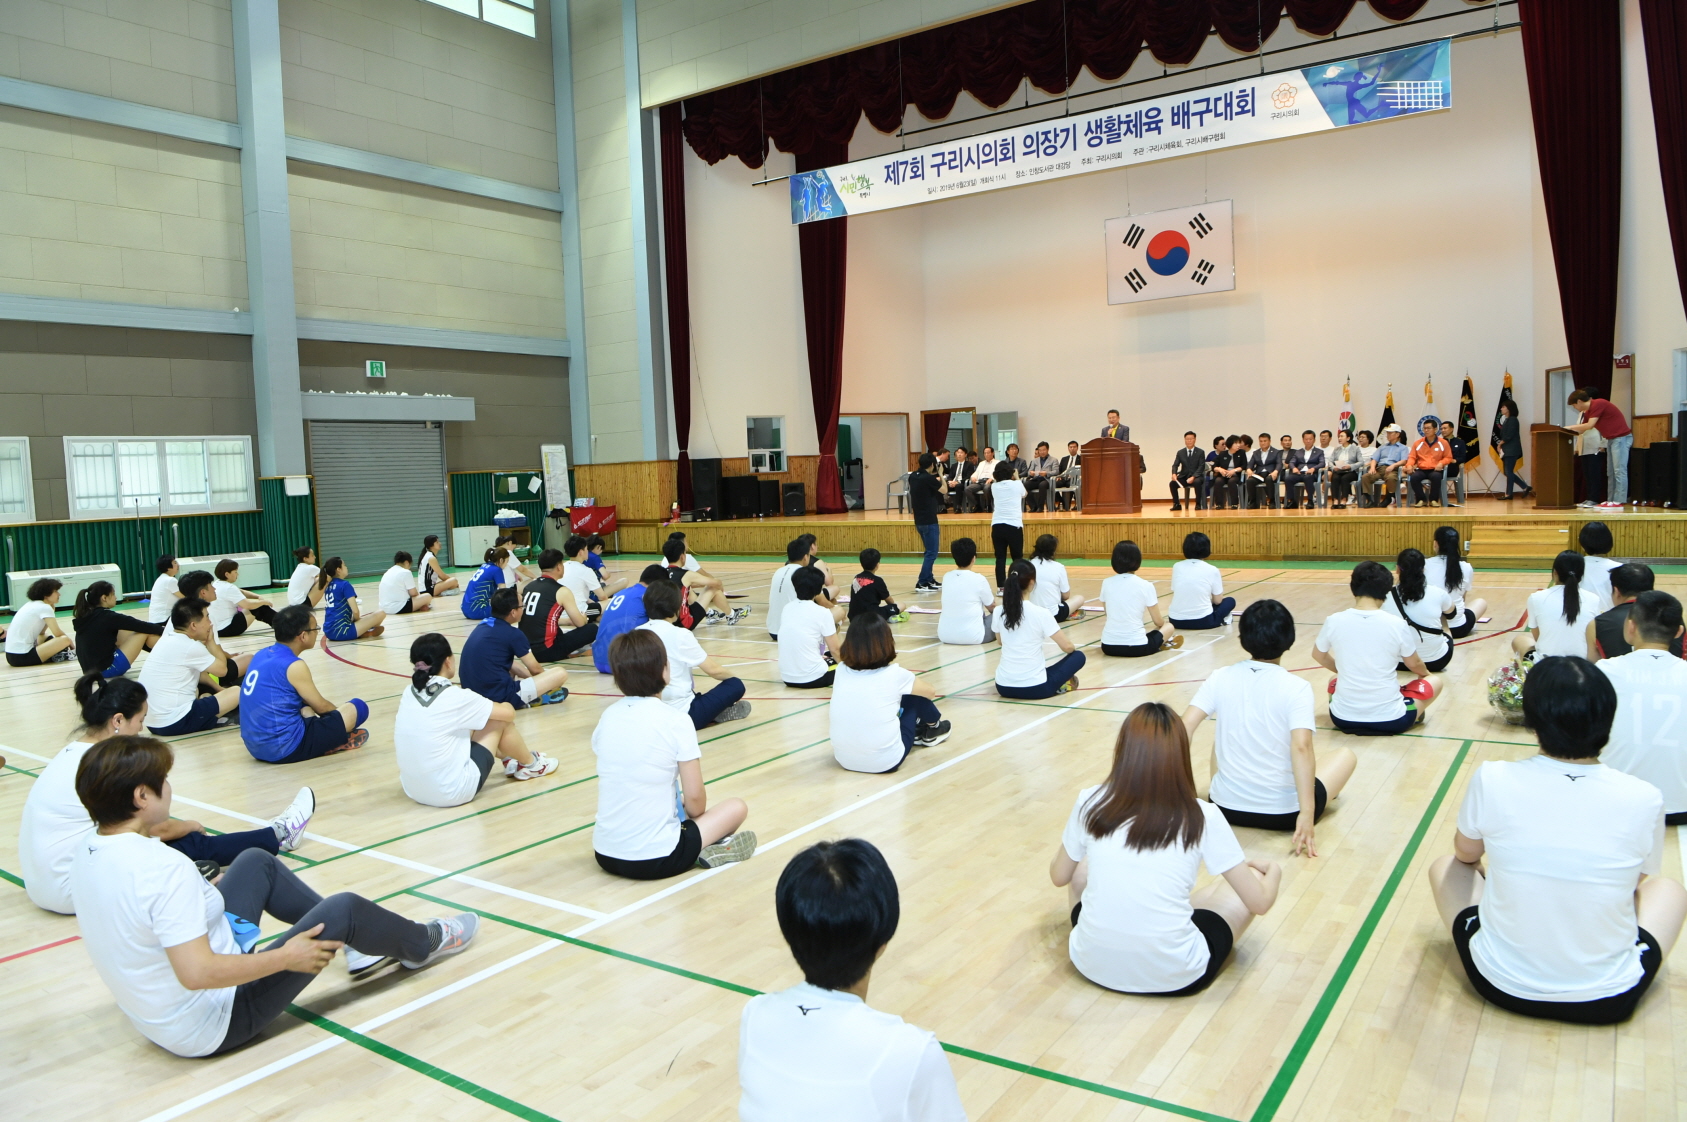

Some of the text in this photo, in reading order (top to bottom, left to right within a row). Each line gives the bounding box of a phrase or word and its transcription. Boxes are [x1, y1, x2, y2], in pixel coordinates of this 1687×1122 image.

[1270, 108, 1300, 120] 구리시의회
[884, 86, 1256, 186] 제7회 구리시의회 의장기 생활체육 배구대회
[939, 182, 956, 192] 2019년
[980, 175, 995, 185] 개회식
[995, 172, 1007, 182] 11시
[1029, 165, 1055, 176] 인창도서관
[1055, 161, 1071, 171] 대강당
[1095, 151, 1123, 164] 구리시의회
[1132, 148, 1144, 157] 주관
[1185, 131, 1226, 146] 구리시배구협회
[605, 594, 625, 611] 19
[243, 669, 259, 696] 9
[1625, 669, 1653, 685] KIM
[1630, 692, 1682, 748] 12
